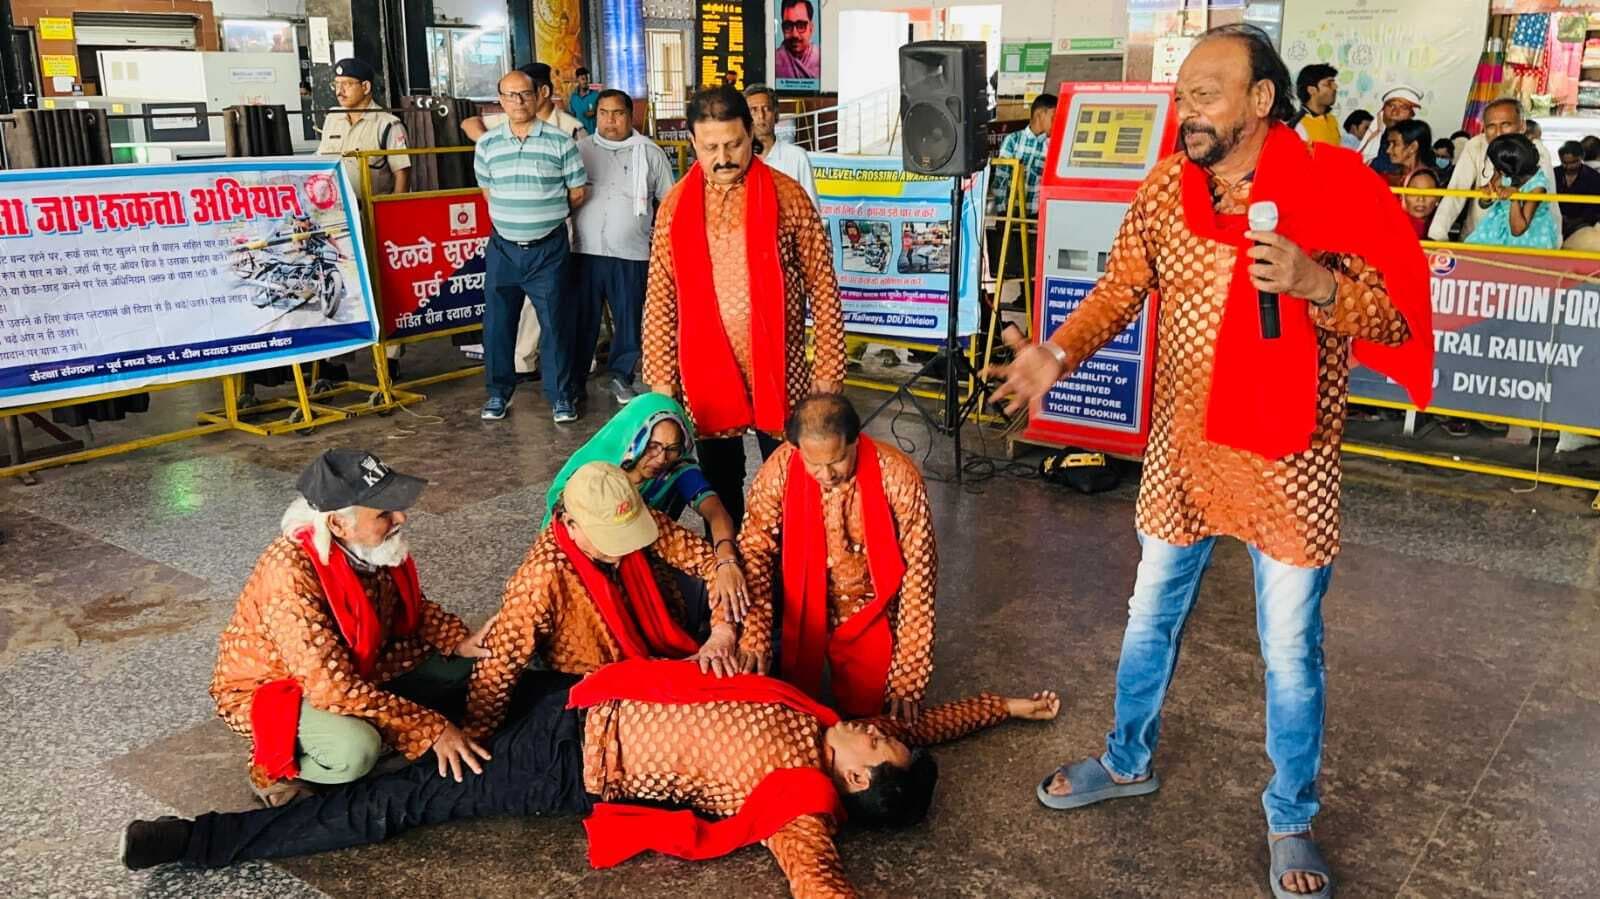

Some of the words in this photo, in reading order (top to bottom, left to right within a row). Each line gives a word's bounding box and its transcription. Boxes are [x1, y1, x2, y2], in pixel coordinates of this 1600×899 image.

[827, 168, 854, 181] LEVEL
[856, 169, 898, 182] CROSSING
[31, 189, 186, 234] जागरूकता
[189, 177, 303, 223] अभियान
[383, 235, 437, 270] रेलवे
[412, 270, 444, 307] पूर्व
[448, 272, 487, 294] मध्य
[1430, 277, 1550, 324] ROTECTION
[1551, 287, 1600, 329] FOR
[395, 311, 423, 329] पंडित
[425, 308, 444, 324] दीन
[446, 305, 472, 320] दयाल
[905, 315, 935, 326] Division
[107, 358, 121, 373] पूर्व
[182, 347, 201, 359] दीन
[202, 346, 229, 357] दयाल
[1432, 330, 1485, 358] TRAL
[1488, 335, 1584, 368] RAILWAY
[1070, 371, 1112, 384] LABILITY
[1115, 376, 1128, 386] OF
[1086, 361, 1120, 373] CHECK
[1452, 371, 1553, 403] DIVISION
[1048, 402, 1081, 414] TICKET
[1083, 407, 1127, 422] BOOKING
[1049, 391, 1083, 403] TRAINS
[1085, 395, 1122, 409] BEFORE
